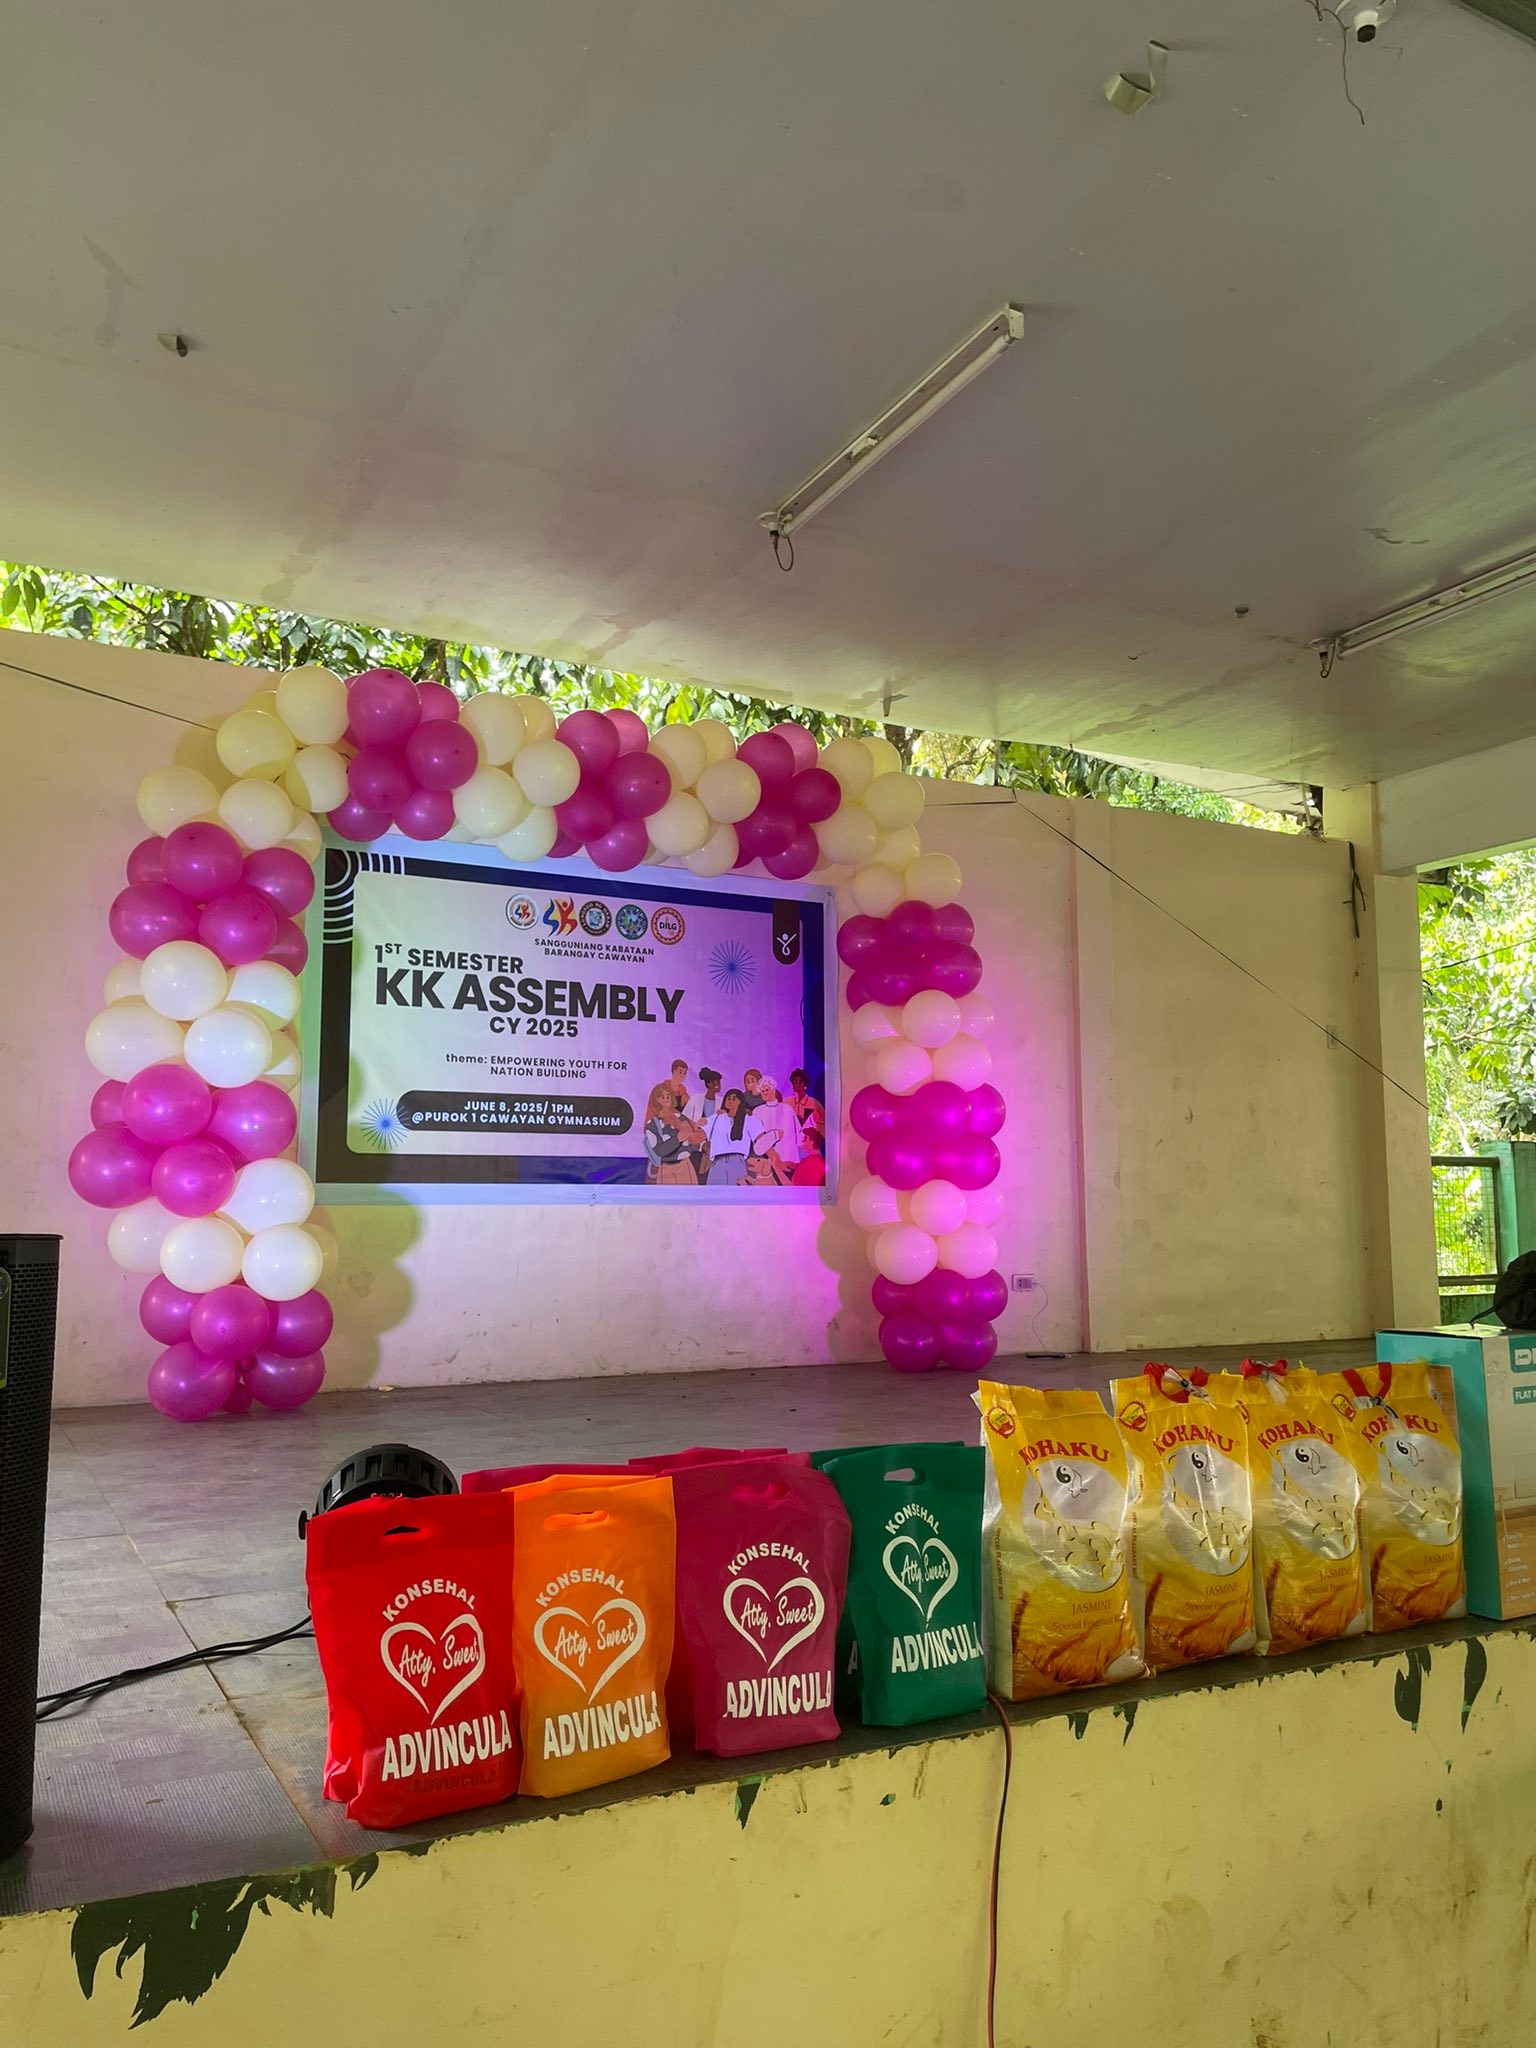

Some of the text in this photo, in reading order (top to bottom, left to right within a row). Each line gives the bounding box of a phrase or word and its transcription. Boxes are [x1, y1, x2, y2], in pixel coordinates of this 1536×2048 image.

[659, 921, 677, 930] DILG
[375, 943, 524, 974] 1ST SEMESTER
[534, 938, 654, 956] SANGGUNIANG KABATAAN
[544, 948, 645, 963] BARANGAY CAWAYAN
[375, 967, 685, 1024] KK ASSEMBLY
[490, 1016, 578, 1037] CY 2025
[446, 1053, 628, 1070] theme: EMPOWERING YOUTH FOR
[490, 1066, 587, 1079] NATION BUILDING
[411, 1111, 621, 1127] @PUROK 1 CAWAYAN GYMNASIUM
[464, 1101, 574, 1114] JUNE 8, 2025/ 1PM
[1515, 1390, 1531, 1400] FLAT
[1153, 1424, 1234, 1456] KOHAKU
[1257, 1420, 1335, 1449] KOHAKU
[1362, 1414, 1439, 1444] KOHKU
[1018, 1439, 1109, 1466] KOHAKU
[884, 1503, 941, 1535] KONSEHAL
[727, 1542, 813, 1576] KONSEHAL
[924, 1553, 949, 1583] Sweet
[382, 1578, 478, 1623] KONSEHAL
[535, 1568, 625, 1608] KONSEHAL
[740, 1595, 814, 1639] Atty. Sweet
[554, 1618, 635, 1668] Atty. Sweet
[891, 1621, 984, 1674] ADVINCULA
[399, 1644, 436, 1688] Atty.
[722, 1670, 832, 1719] ADVINCULA
[543, 1690, 661, 1760] ADVINCULA
[381, 1710, 513, 1782] ADVINCULA
